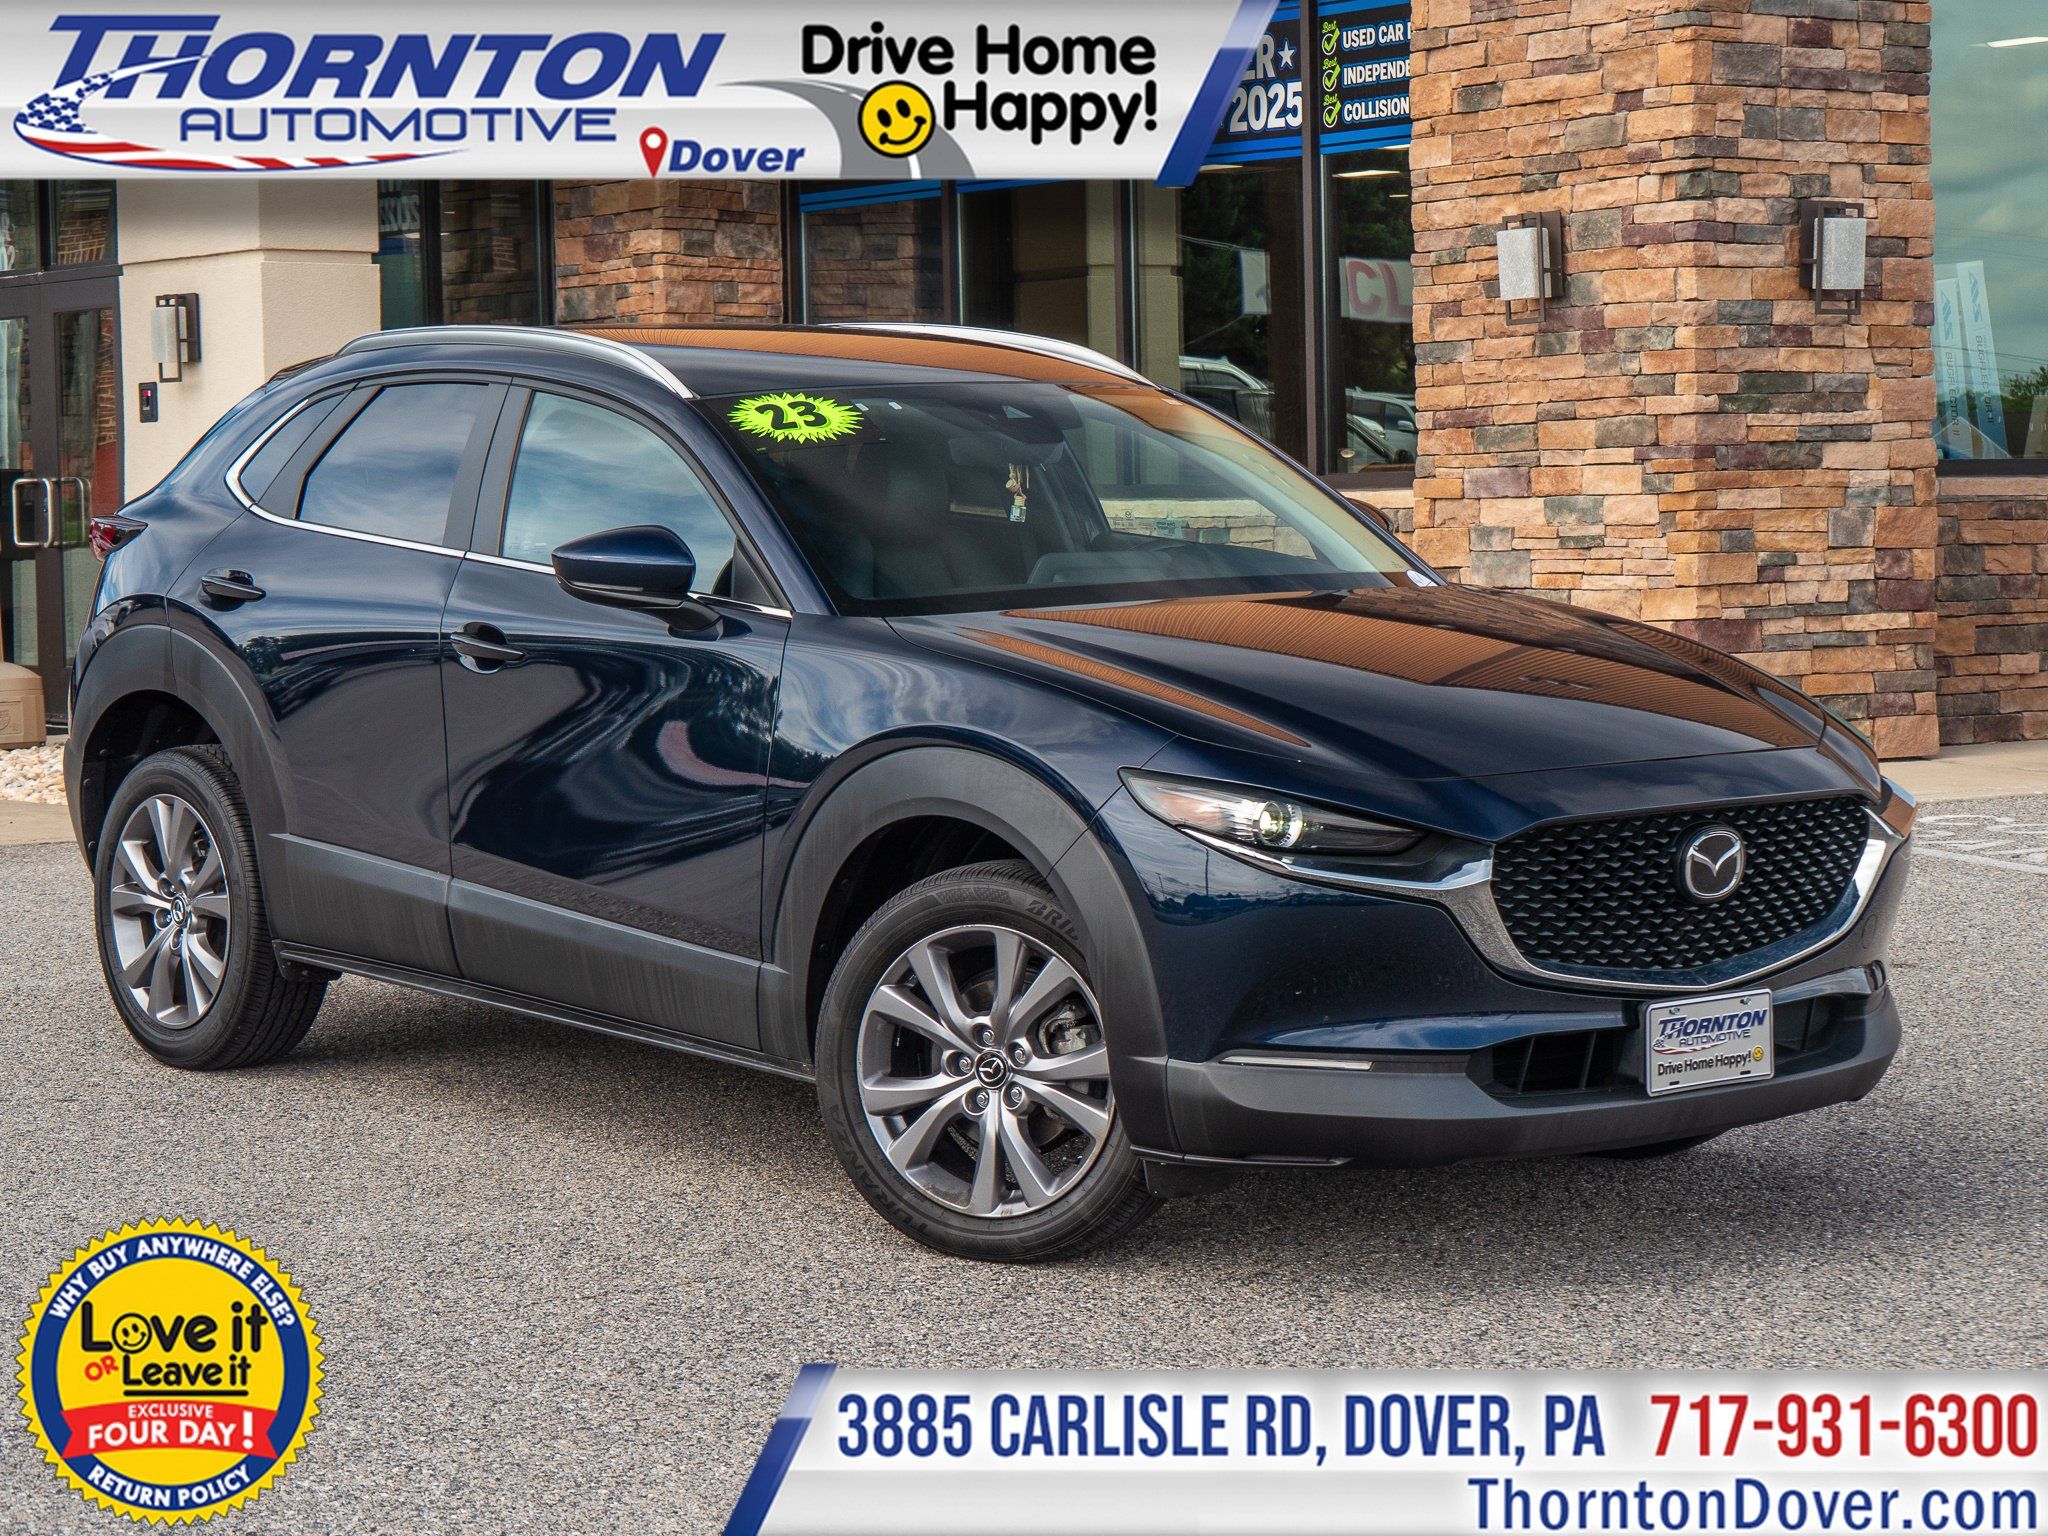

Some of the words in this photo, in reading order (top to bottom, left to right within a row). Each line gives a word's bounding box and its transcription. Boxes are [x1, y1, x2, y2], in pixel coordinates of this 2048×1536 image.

[1342, 26, 1376, 49] USED
[1378, 23, 1404, 44] CAR
[1229, 81, 1303, 133] 2025
[1343, 96, 1410, 122] COLLISION
[754, 401, 828, 431] 23
[1658, 1009, 1768, 1039] THORNTON
[1679, 1029, 1751, 1047] AUTOMOTIVE
[1657, 1061, 1683, 1076] Drive
[1684, 1057, 1714, 1072] Home
[1715, 1050, 1751, 1068] Happy!
